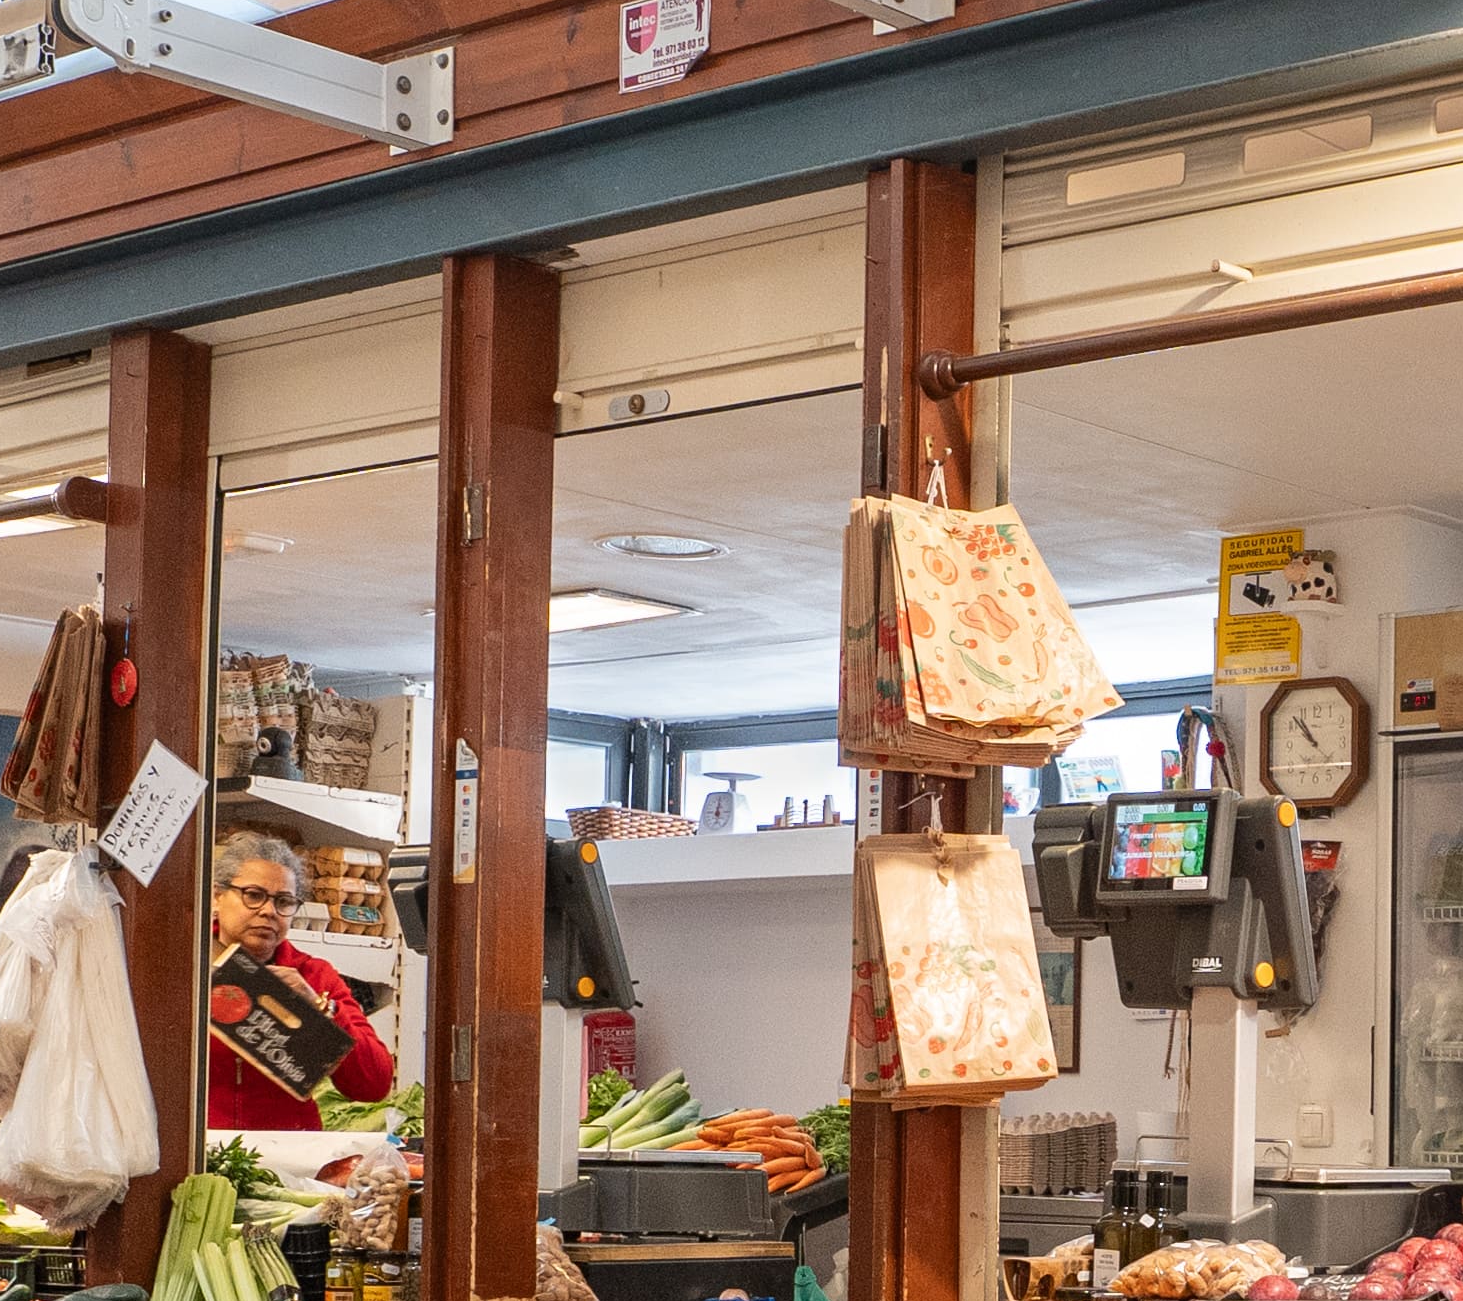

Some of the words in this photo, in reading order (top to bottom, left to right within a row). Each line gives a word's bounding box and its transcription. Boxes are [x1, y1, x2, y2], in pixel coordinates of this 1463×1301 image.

[629, 14, 656, 31] intec
[665, 44, 677, 56] 971
[698, 36, 705, 47] 12
[1229, 535, 1294, 549] SEGURIDAD
[1229, 548, 1264, 560] GABRIEL
[1227, 561, 1245, 572] ZONA
[1312, 705, 1322, 719] 12
[1312, 771, 1319, 784] 6
[1191, 957, 1223, 969] DIBAL
